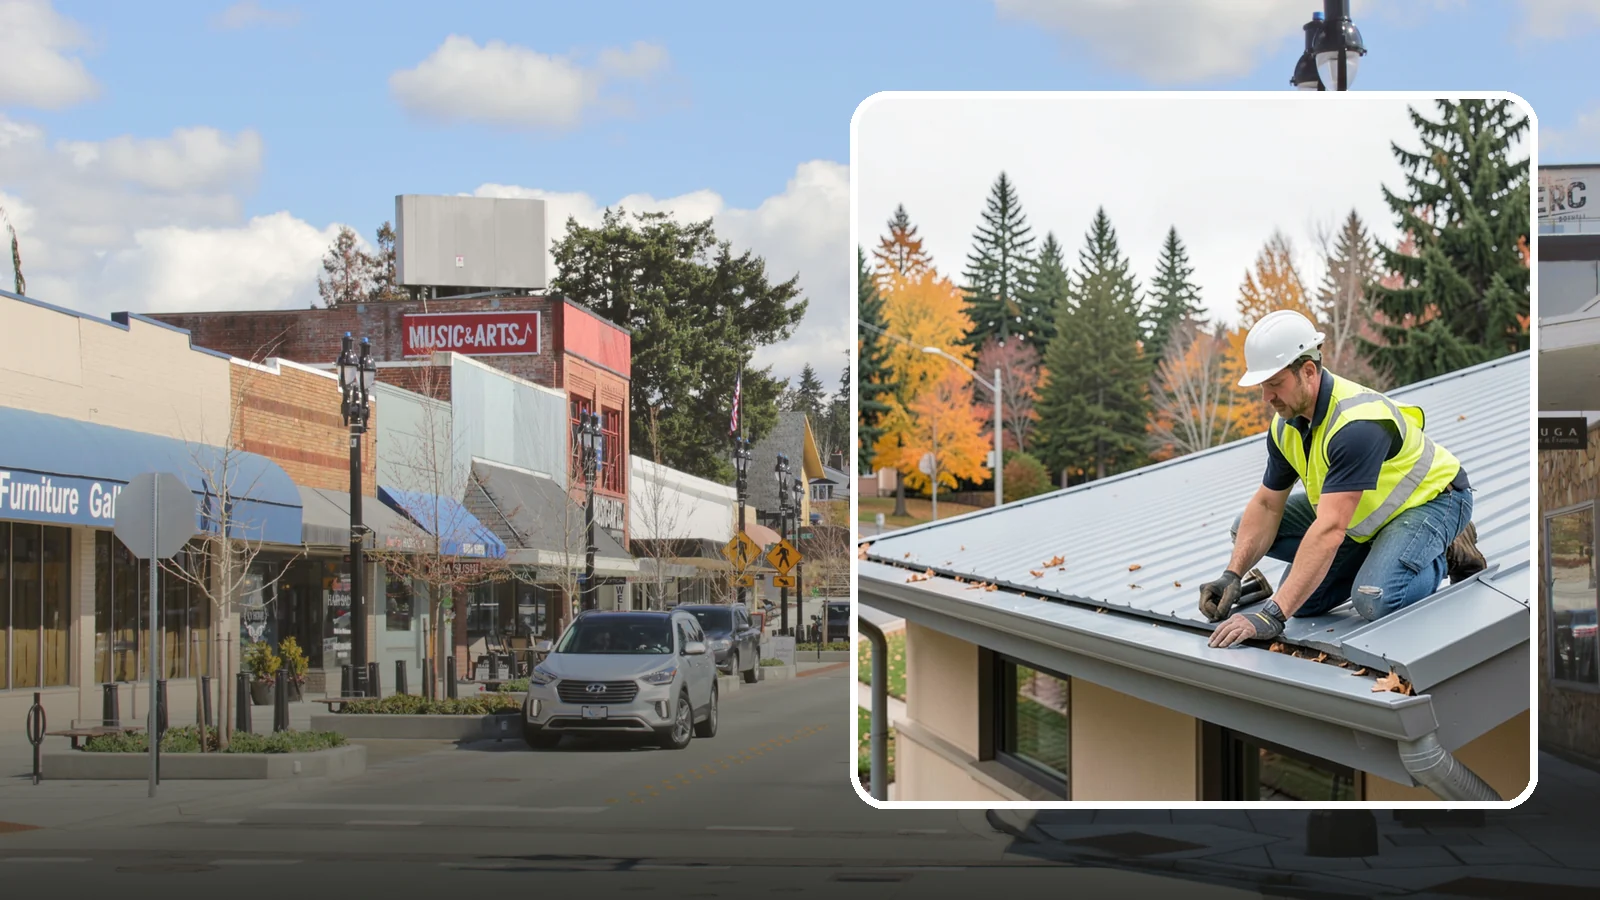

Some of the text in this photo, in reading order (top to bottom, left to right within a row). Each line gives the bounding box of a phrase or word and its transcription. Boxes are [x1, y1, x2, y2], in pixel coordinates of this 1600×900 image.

[408, 322, 520, 349] MUSIC&ARTS
[0, 471, 122, 519] Furniture Gal
